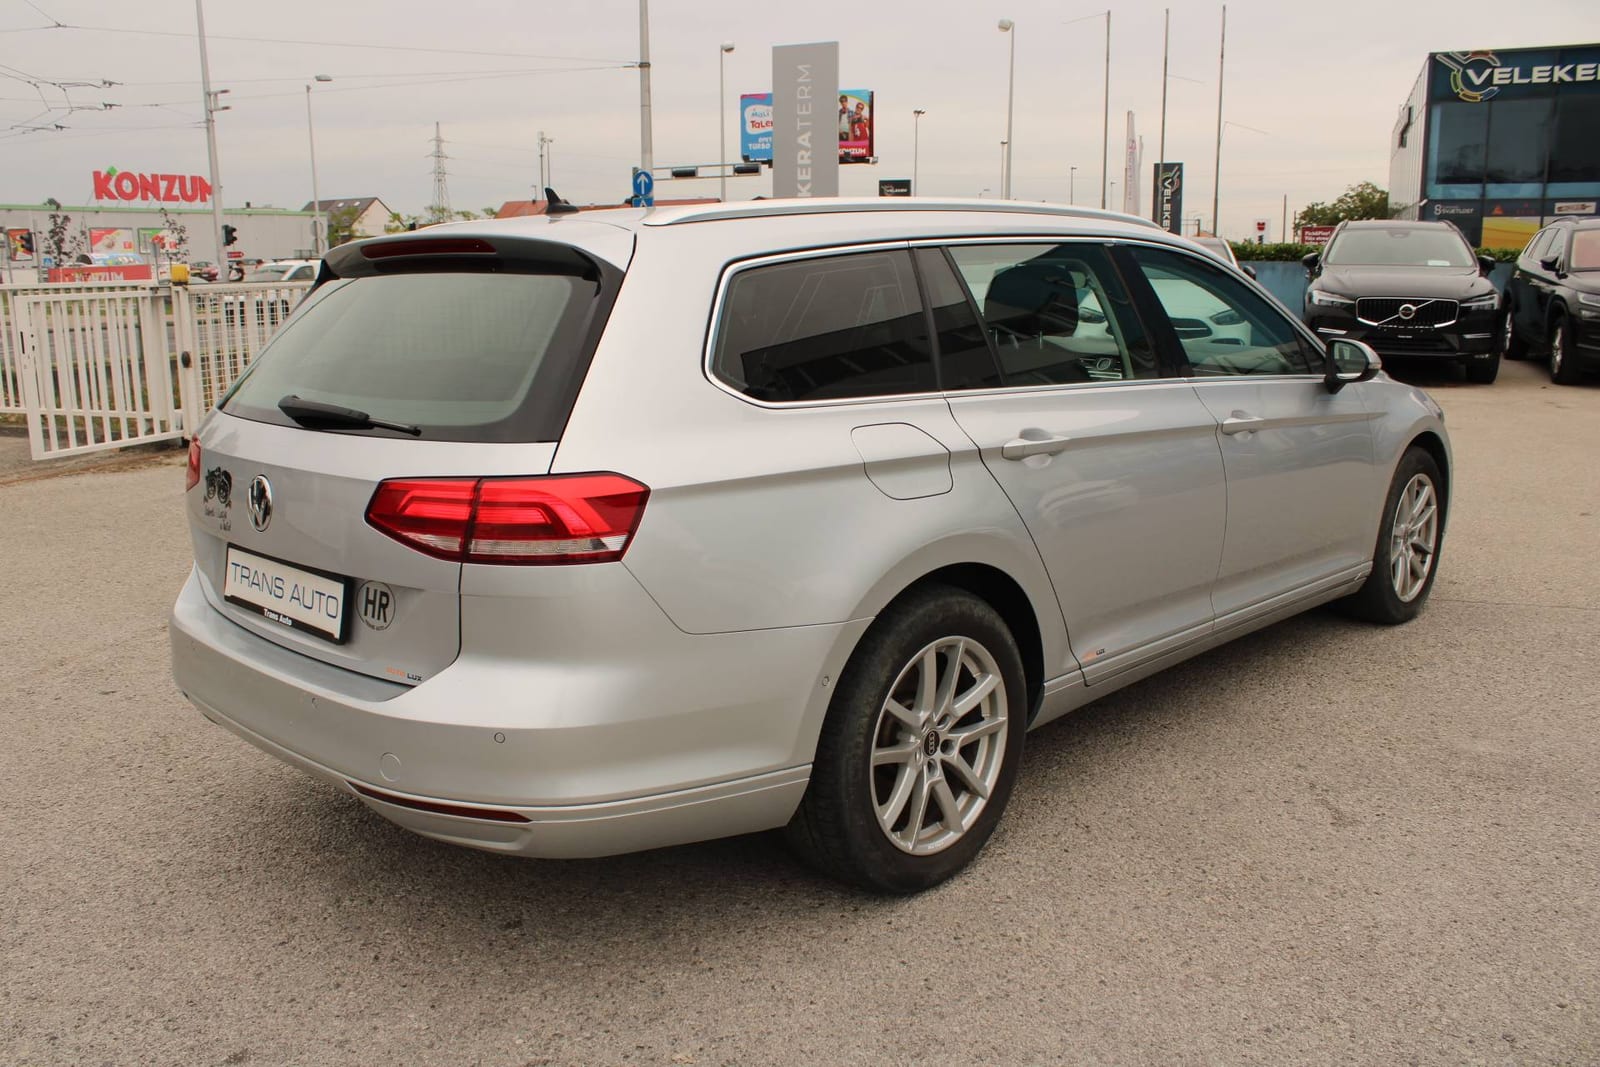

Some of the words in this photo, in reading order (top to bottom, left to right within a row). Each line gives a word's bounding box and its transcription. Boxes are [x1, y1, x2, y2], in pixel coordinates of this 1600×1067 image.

[1466, 63, 1600, 86] VELEKE
[797, 64, 812, 197] KERATERM
[231, 562, 285, 599] TRANS
[289, 583, 339, 619] AUTO
[364, 586, 390, 623] HR
[263, 608, 279, 621] Trans
[279, 614, 293, 626] Auto
